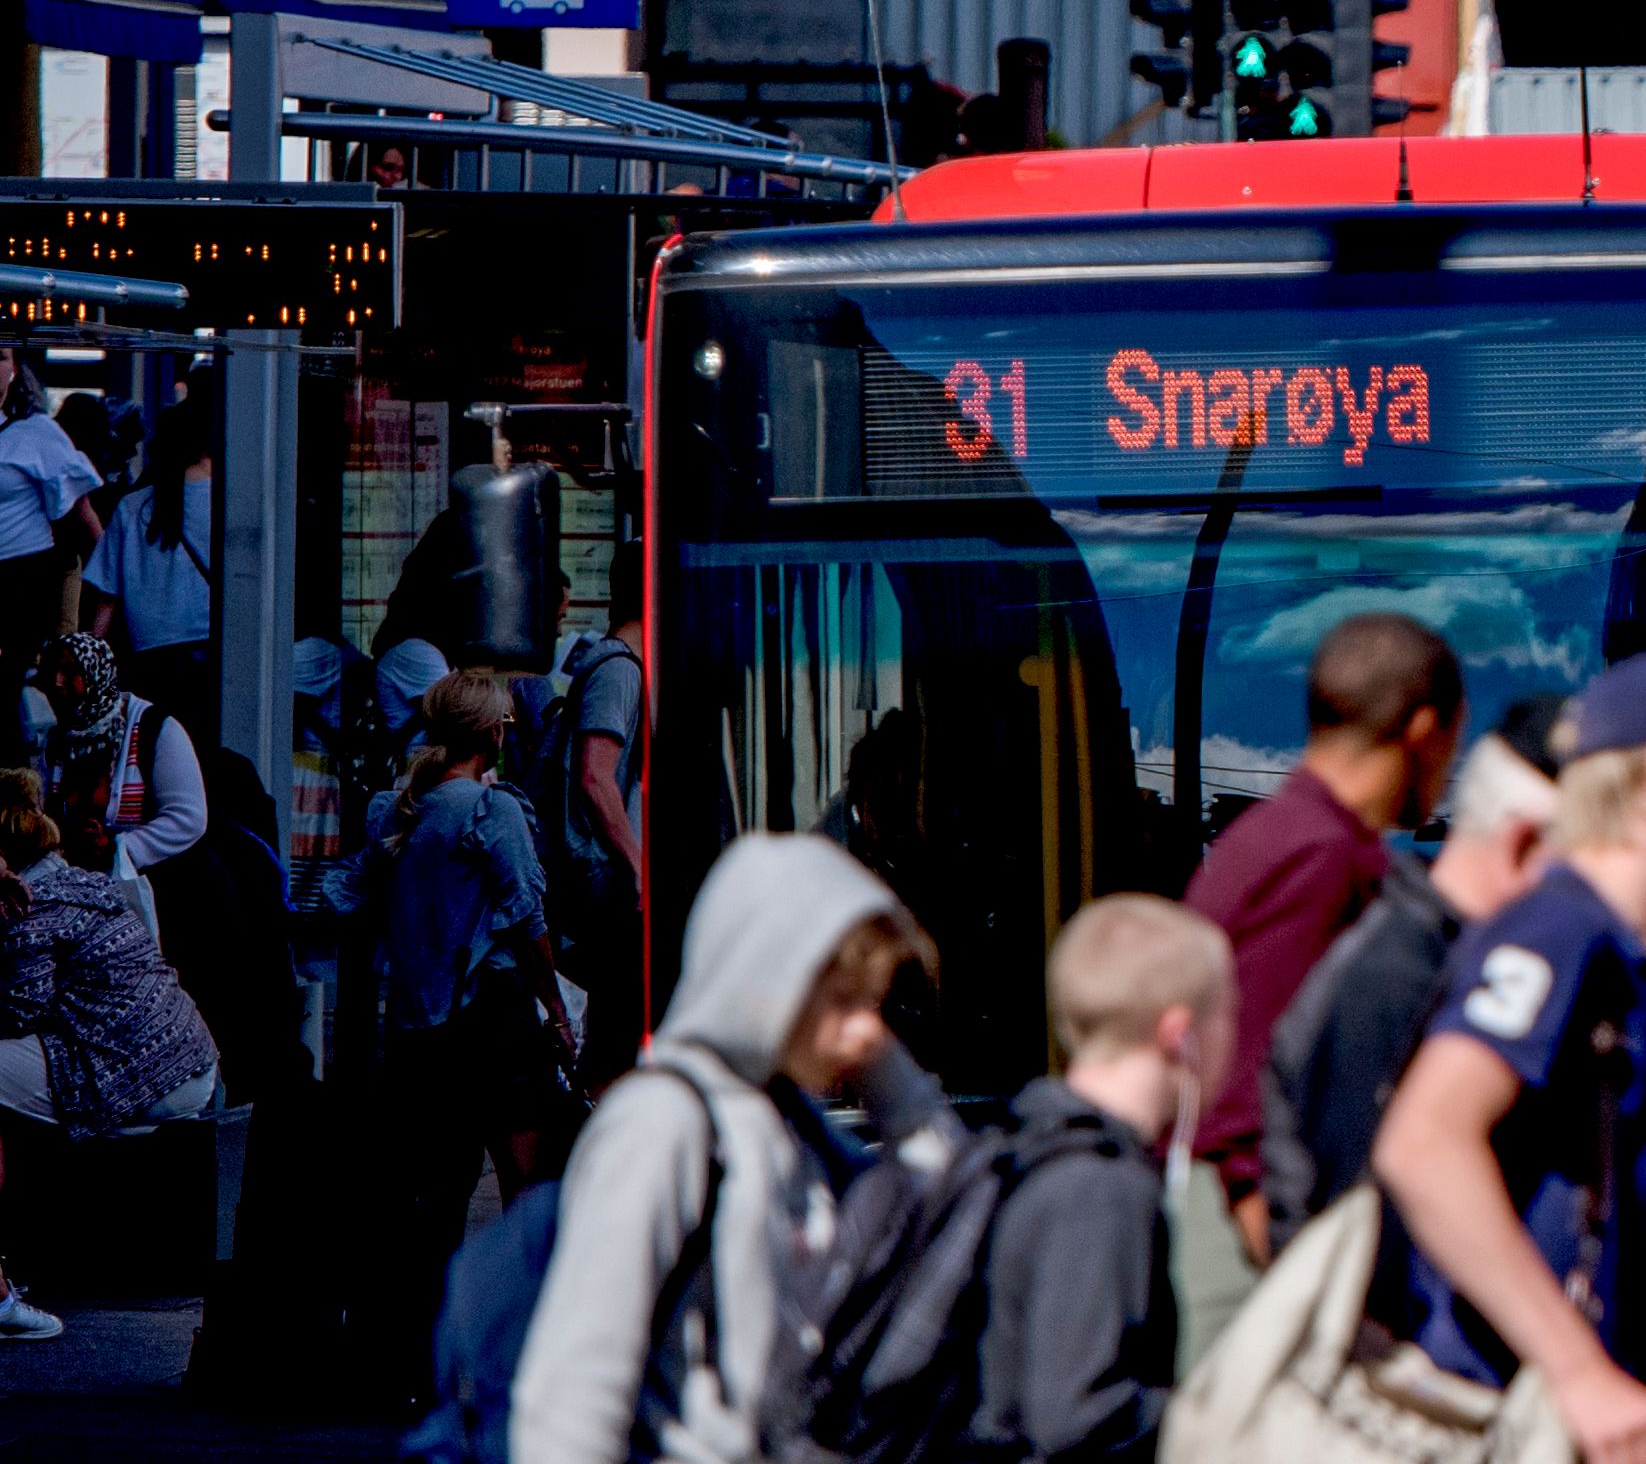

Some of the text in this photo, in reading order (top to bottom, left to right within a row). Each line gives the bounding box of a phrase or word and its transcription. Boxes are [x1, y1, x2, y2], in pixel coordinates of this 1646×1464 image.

[944, 349, 1430, 467] 31 Snarøya
[1464, 945, 1554, 1038] 3
